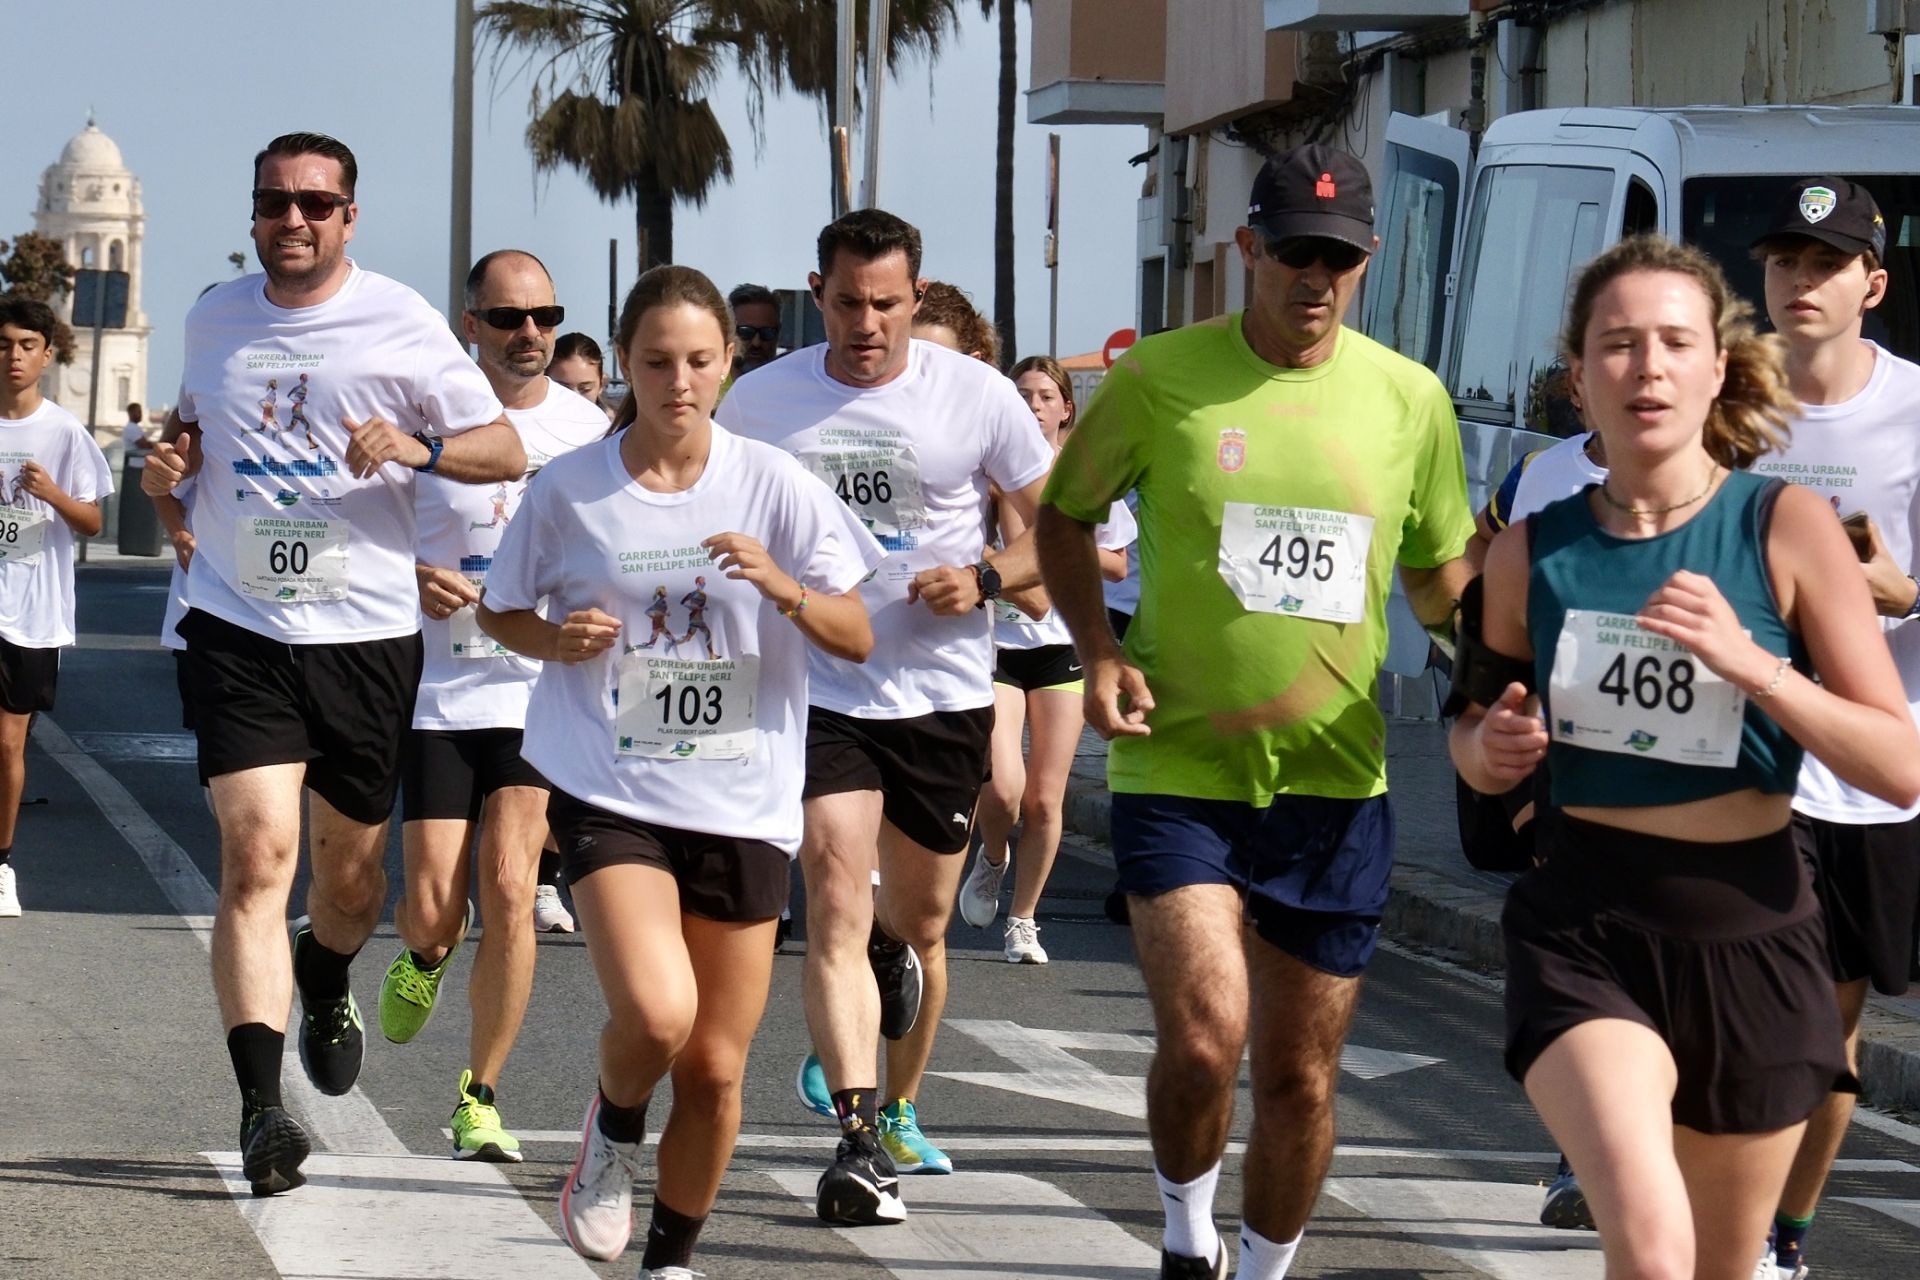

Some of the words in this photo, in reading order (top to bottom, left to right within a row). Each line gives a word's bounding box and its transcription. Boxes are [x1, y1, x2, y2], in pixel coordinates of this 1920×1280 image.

[247, 353, 287, 361] CARRERA
[289, 353, 325, 361] URBANA
[246, 361, 264, 369] SAN
[818, 428, 862, 438] CARRERA
[864, 429, 902, 438] URBANA
[820, 438, 839, 446] SAN
[841, 438, 873, 447] FELIPE
[875, 439, 898, 448] NERI
[1758, 463, 1809, 473] CARRERA
[1812, 464, 1858, 476] URBANA
[836, 470, 892, 506] 466
[1825, 477, 1854, 488] NERI
[1254, 507, 1302, 519] CARRERA
[1306, 511, 1348, 525] URBANA
[253, 518, 291, 528] CARRERA
[293, 520, 329, 529] URBANA
[1255, 519, 1277, 530] SAN
[1279, 521, 1316, 533] FELIPE
[1318, 525, 1343, 536] NERI
[254, 528, 271, 536] SAN
[273, 529, 302, 538] FELIPE
[304, 530, 326, 539] NERI
[269, 540, 309, 575] 60
[618, 549, 670, 562] CARRERA
[672, 546, 709, 558] URBAN
[1259, 534, 1335, 582] 495
[621, 563, 643, 574] SAN
[647, 560, 685, 572] FELIPE
[1596, 615, 1642, 631] CARRE
[1597, 631, 1620, 645] SAN
[1624, 634, 1669, 651] FELIPE
[647, 659, 694, 669] CARRERA
[697, 660, 736, 671] URBANA
[649, 669, 670, 680] SAN
[672, 671, 706, 682] FELIPE
[709, 671, 732, 681] NERI
[1598, 652, 1695, 714] 468
[655, 684, 722, 726] 103
